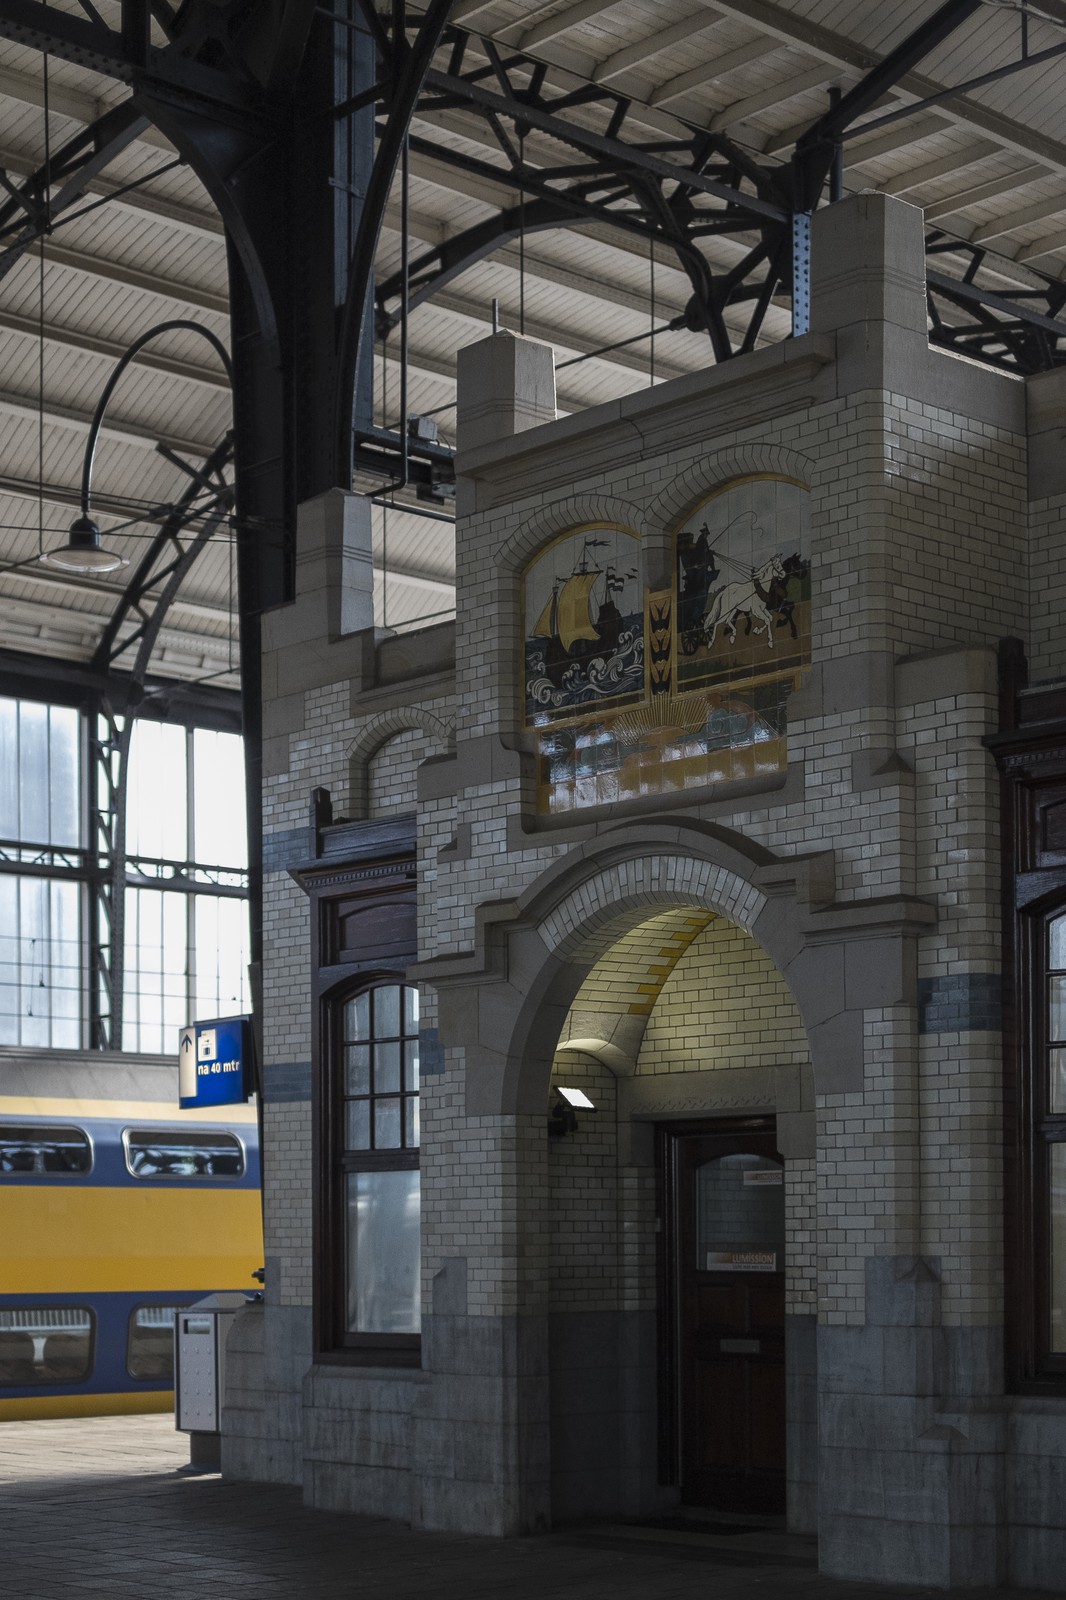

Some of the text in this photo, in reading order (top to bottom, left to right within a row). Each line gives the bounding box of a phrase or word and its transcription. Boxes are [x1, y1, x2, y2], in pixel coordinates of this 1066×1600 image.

[198, 1060, 240, 1075] na 40 mtr
